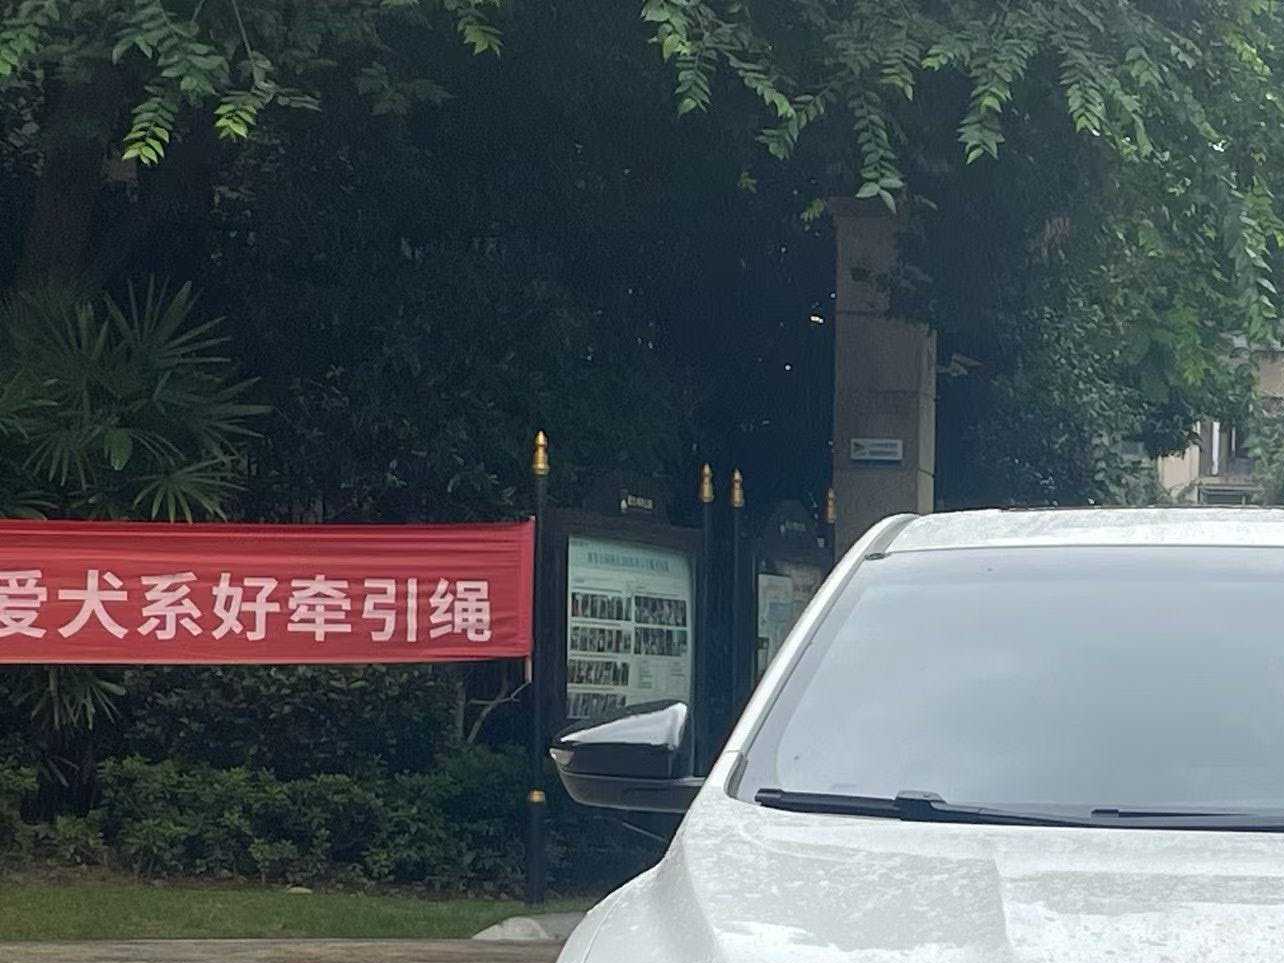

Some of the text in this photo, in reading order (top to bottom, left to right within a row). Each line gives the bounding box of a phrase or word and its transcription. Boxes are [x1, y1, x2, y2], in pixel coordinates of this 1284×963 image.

[0, 569, 492, 642] 爱犬系好牵引绳
